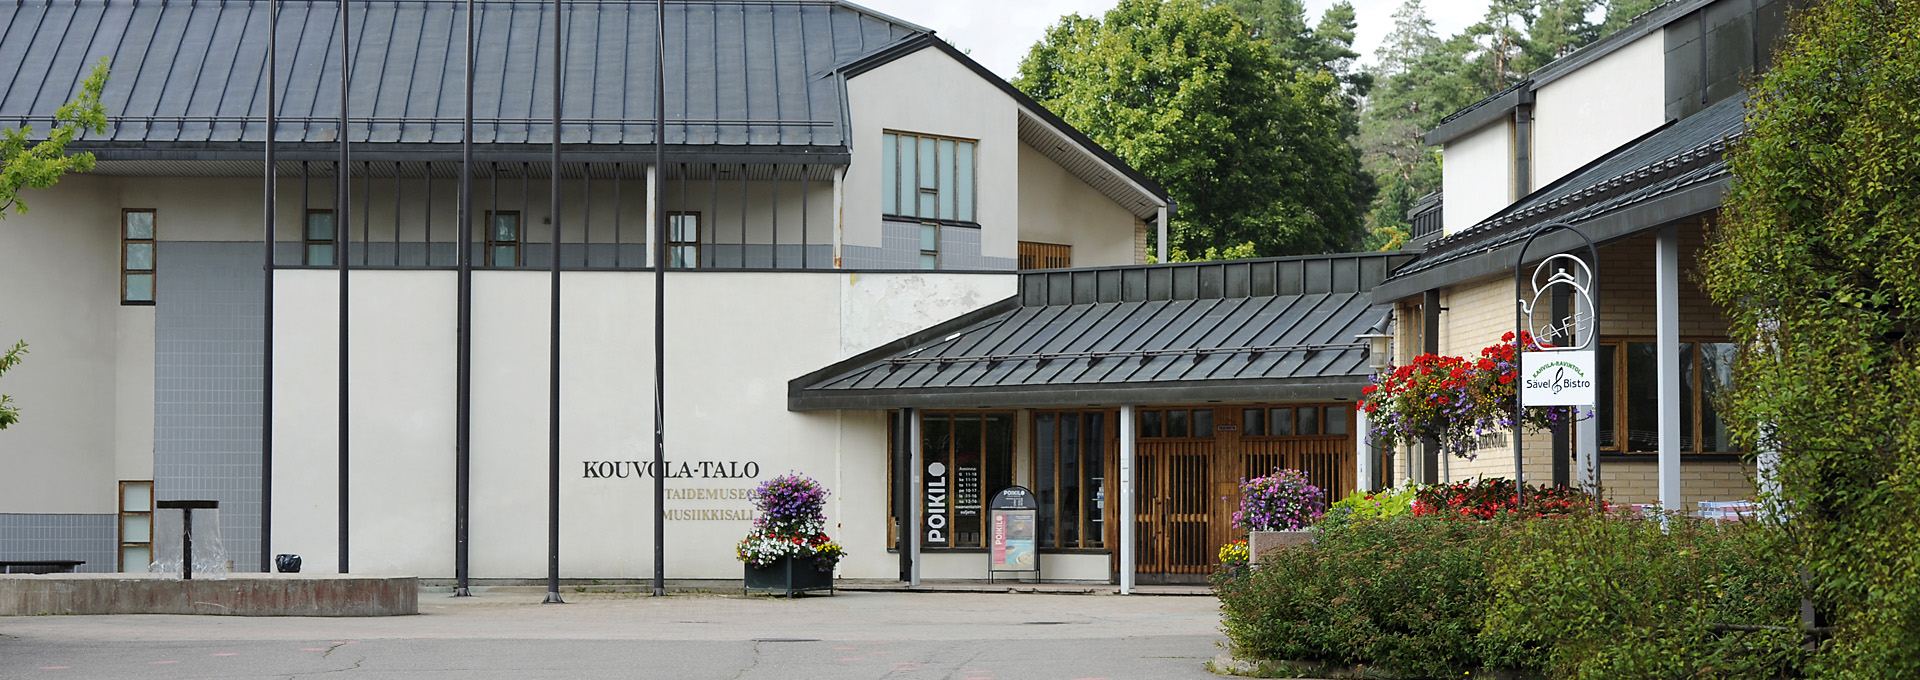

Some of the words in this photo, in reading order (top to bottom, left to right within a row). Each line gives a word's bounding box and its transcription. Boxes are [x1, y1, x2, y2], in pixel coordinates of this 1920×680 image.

[1540, 311, 1587, 342] CAFE
[1532, 361, 1584, 378] KAHVILA-RAVINTOLA
[1526, 379, 1551, 389] Sävel
[1563, 378, 1591, 388] Bistro
[664, 488, 757, 500] TAIDEMUSEO
[928, 462, 945, 542] POIKILO
[663, 509, 753, 520] MUSIIKKISALI
